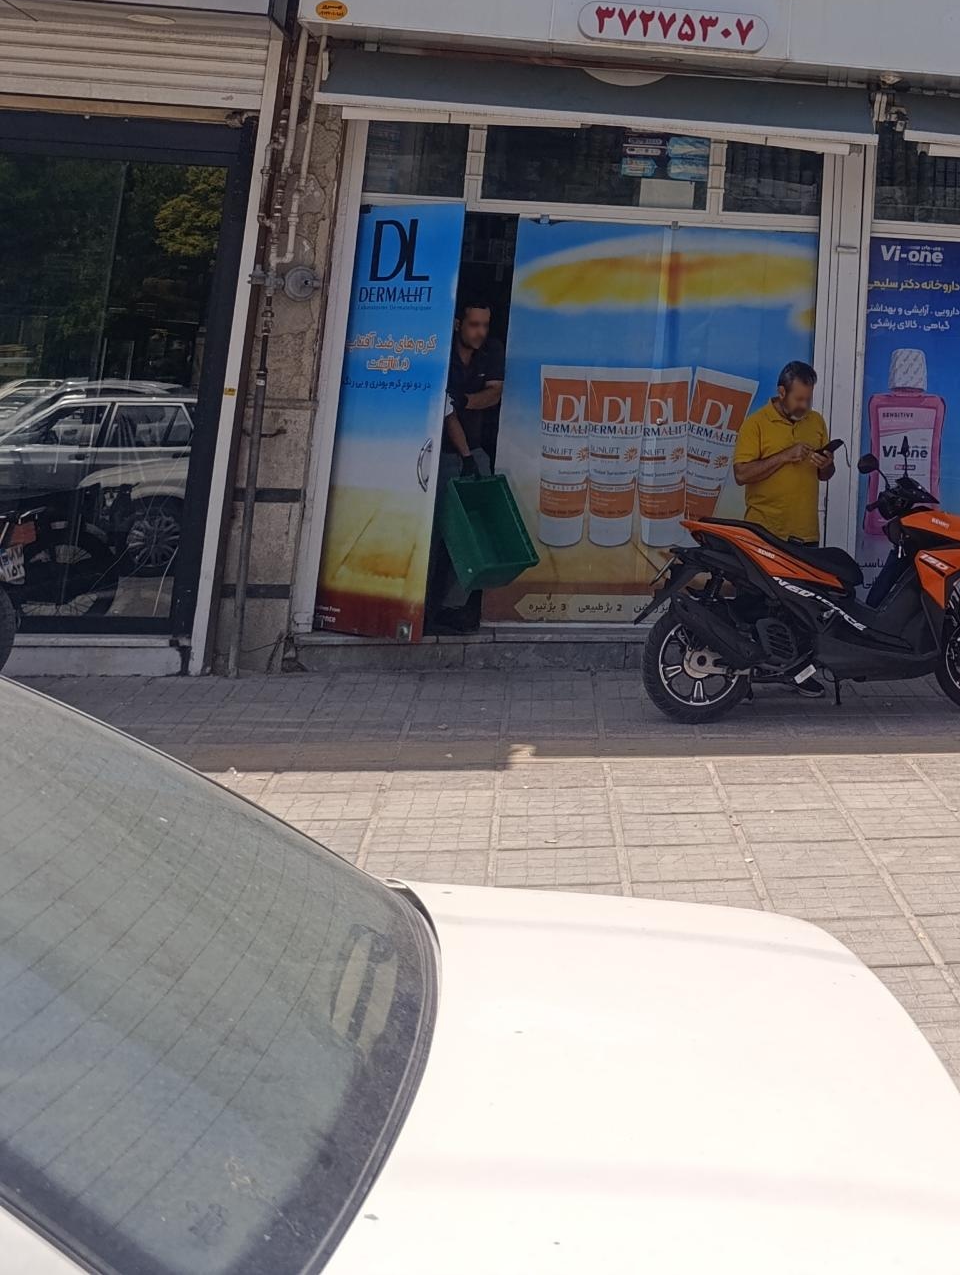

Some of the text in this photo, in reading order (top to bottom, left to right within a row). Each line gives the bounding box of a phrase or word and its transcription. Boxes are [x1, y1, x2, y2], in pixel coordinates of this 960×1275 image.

[595, 6, 754, 46] ۳۷۲۷۵۳۰۷
[368, 218, 430, 282] DL
[880, 244, 944, 264] Vi-one
[899, 278, 920, 291] دکتر
[921, 280, 960, 293] داروخانه
[904, 304, 929, 316] آرایشی
[541, 421, 588, 435] DERMALI
